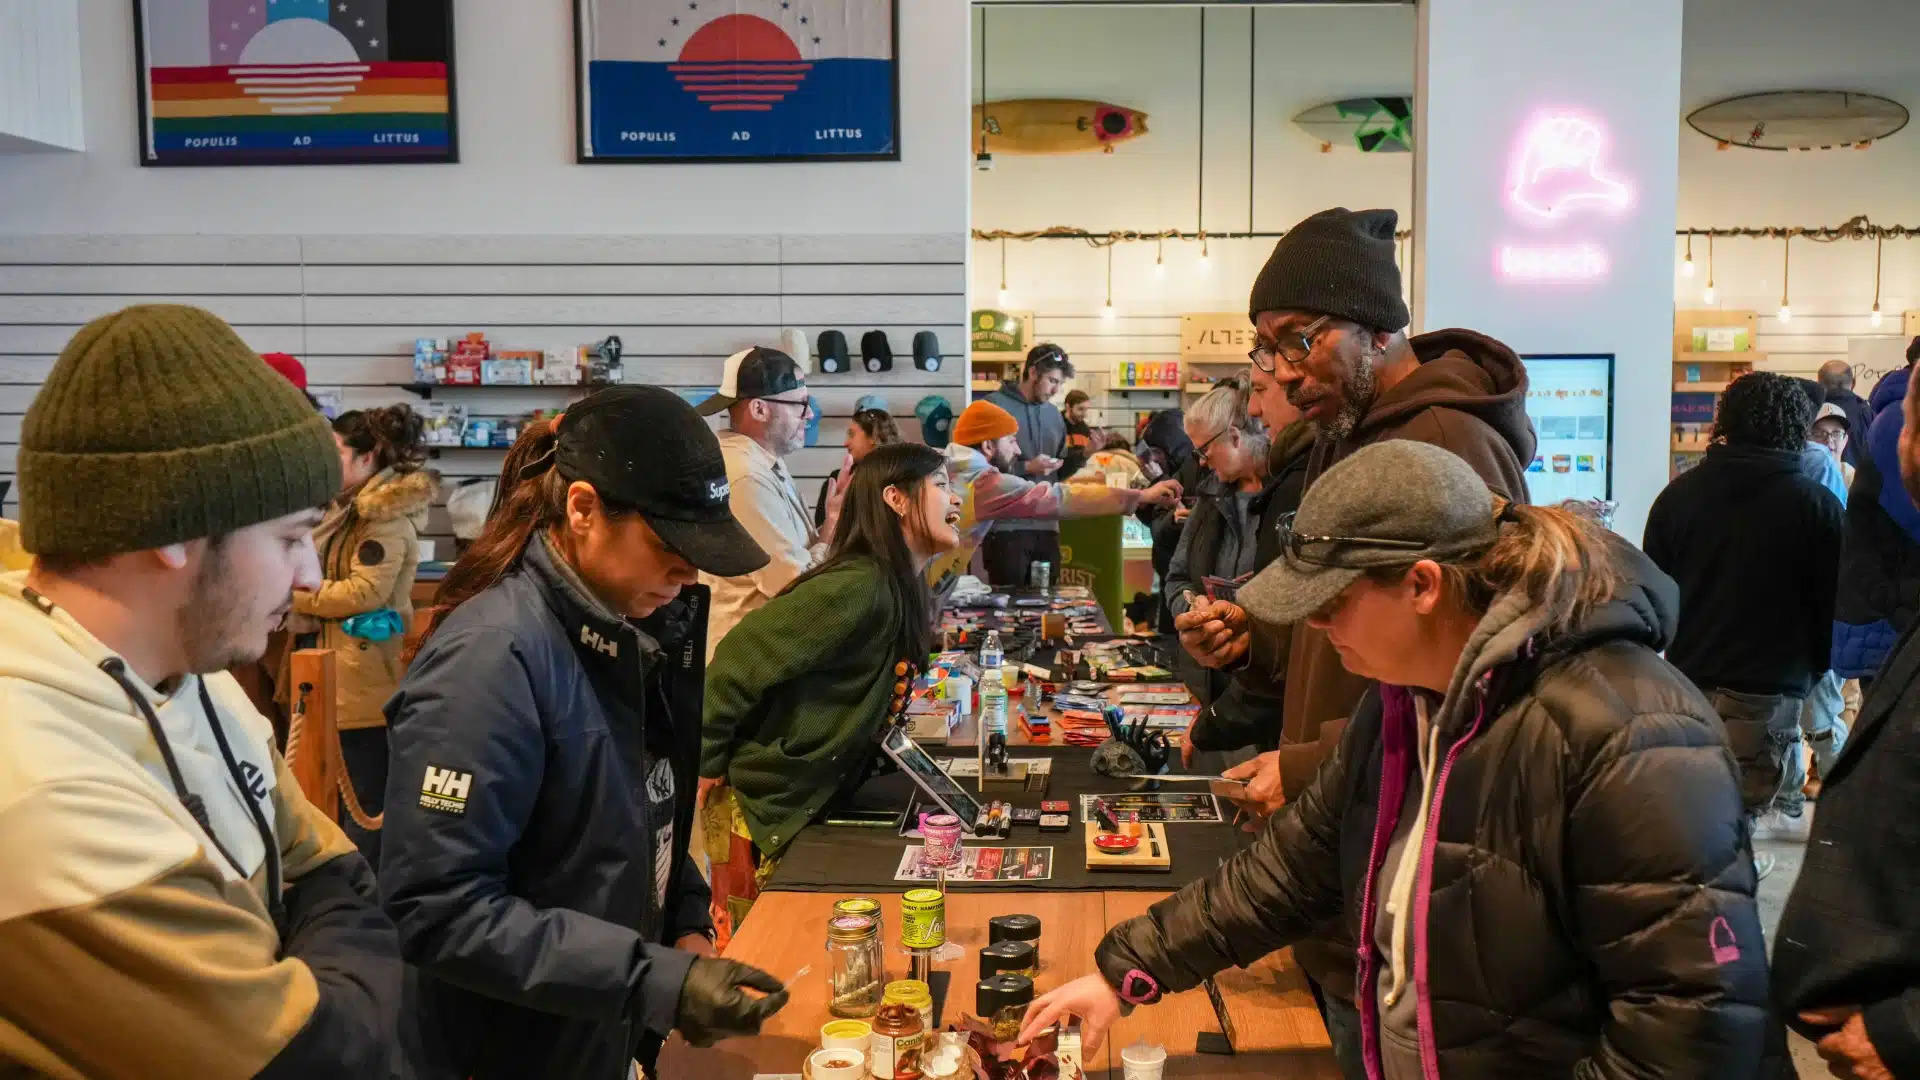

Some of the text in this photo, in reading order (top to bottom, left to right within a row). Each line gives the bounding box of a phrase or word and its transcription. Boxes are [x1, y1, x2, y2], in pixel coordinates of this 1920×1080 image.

[184, 133, 420, 147] POPULIS AD LITTUS
[620, 128, 863, 142] POPULIS AD LITTUS
[580, 624, 618, 657] HH
[422, 765, 472, 799] HH
